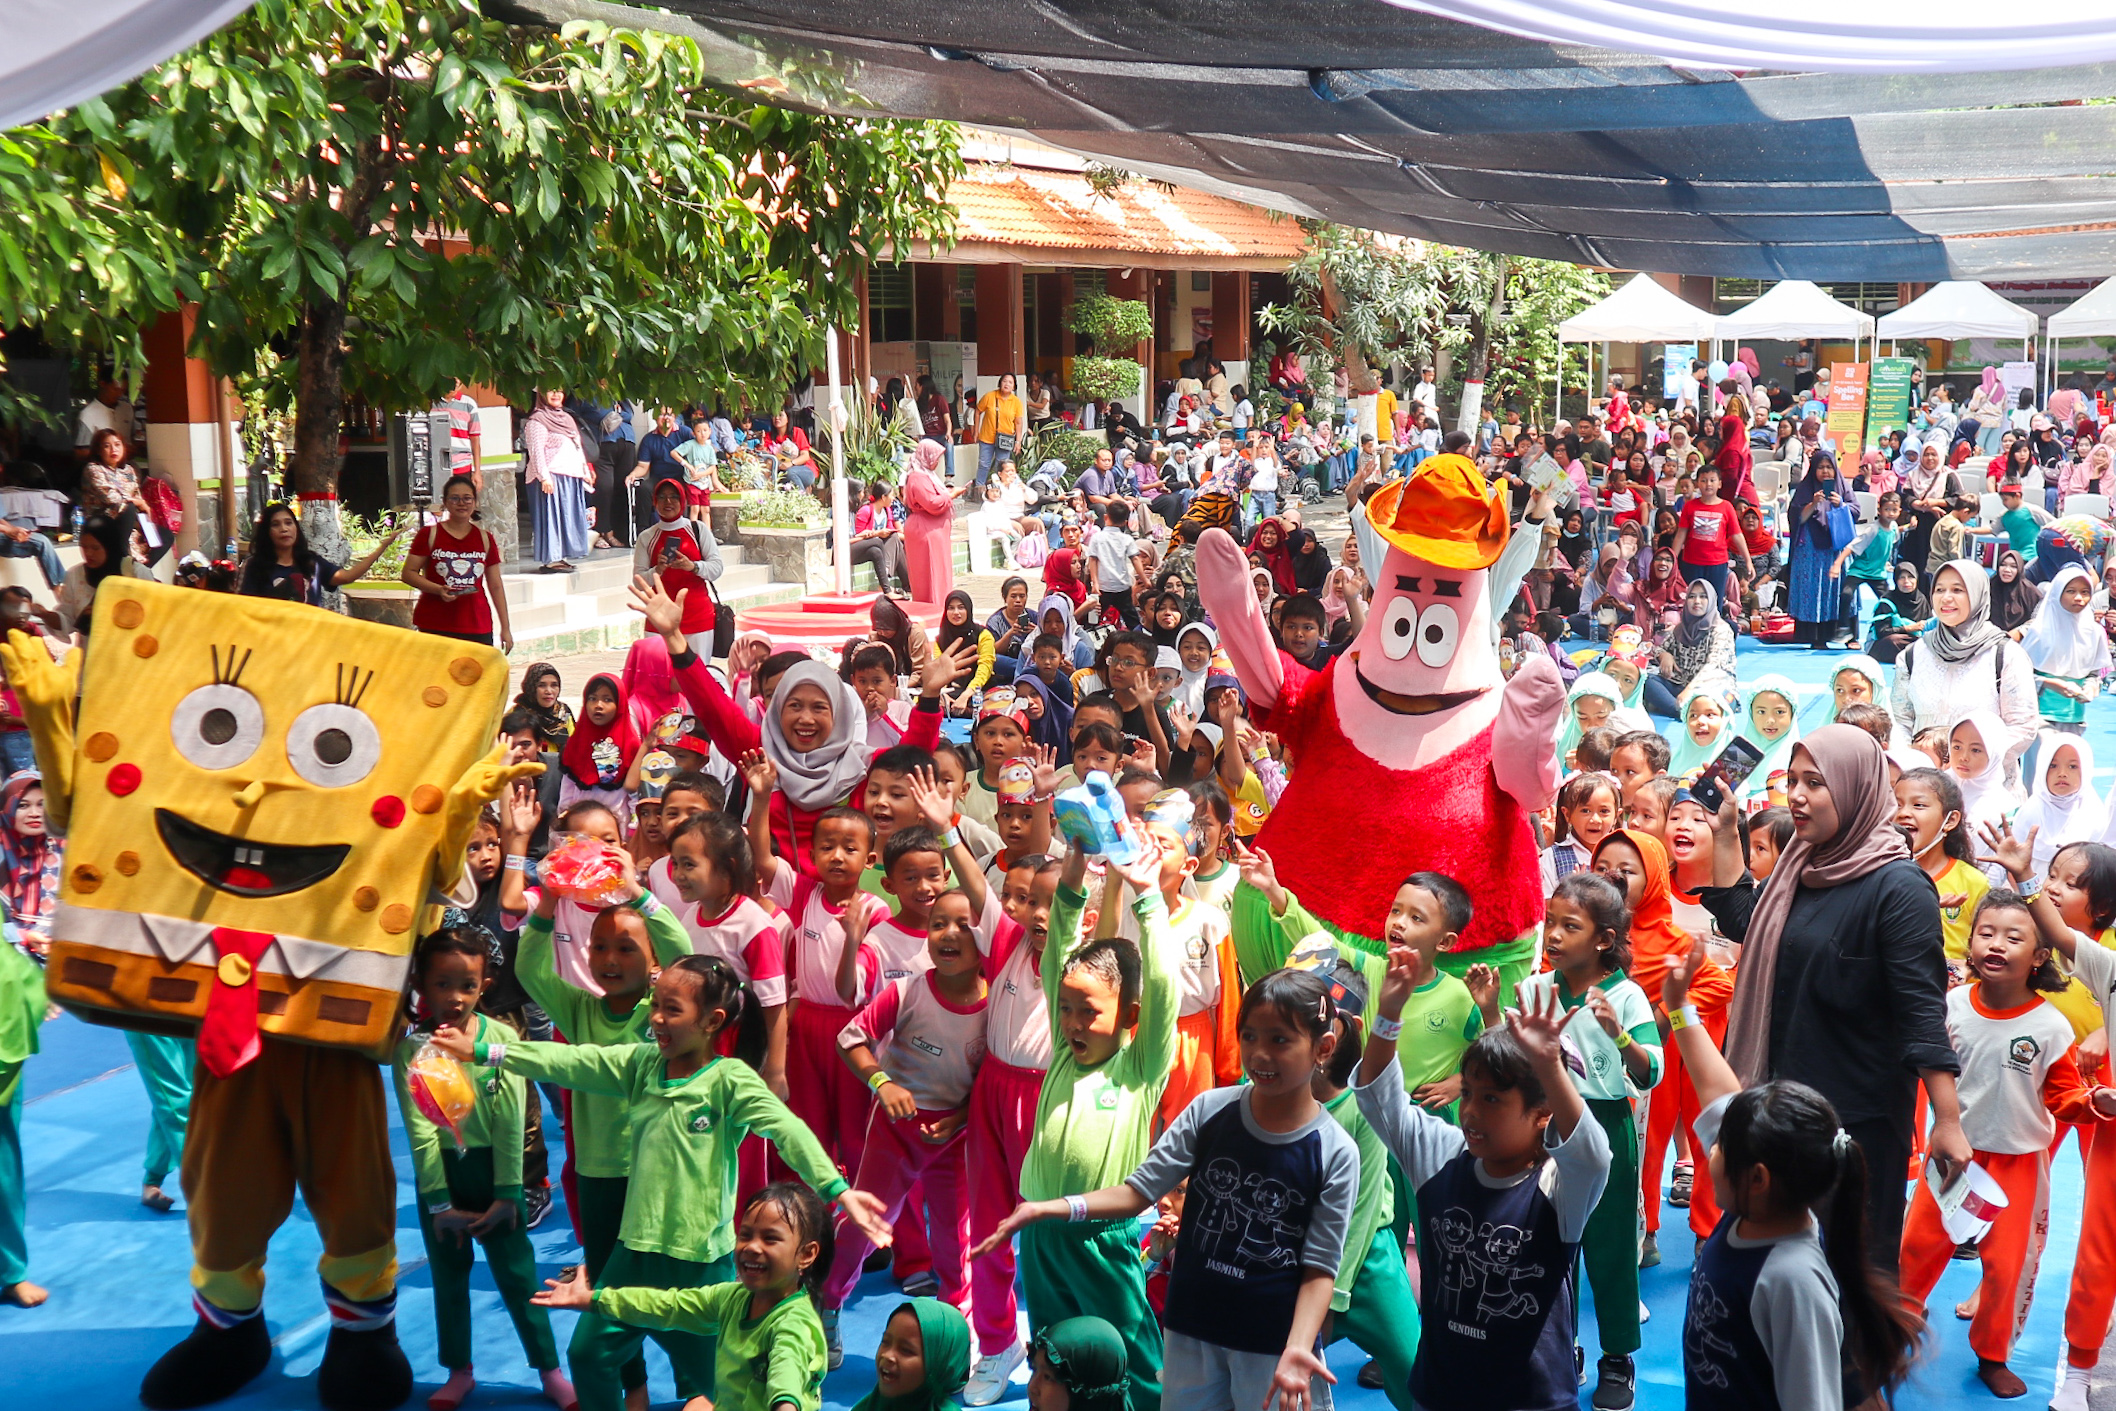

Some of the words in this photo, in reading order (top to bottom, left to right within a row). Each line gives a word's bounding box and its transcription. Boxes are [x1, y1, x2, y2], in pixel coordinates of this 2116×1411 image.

[1833, 385, 1864, 396] Spelling
[431, 548, 459, 560] Keep
[460, 551, 487, 560] doing
[445, 576, 475, 588] Good
[1205, 1257, 1246, 1280] JASMINE
[1447, 1320, 1487, 1340] GENDHIS
